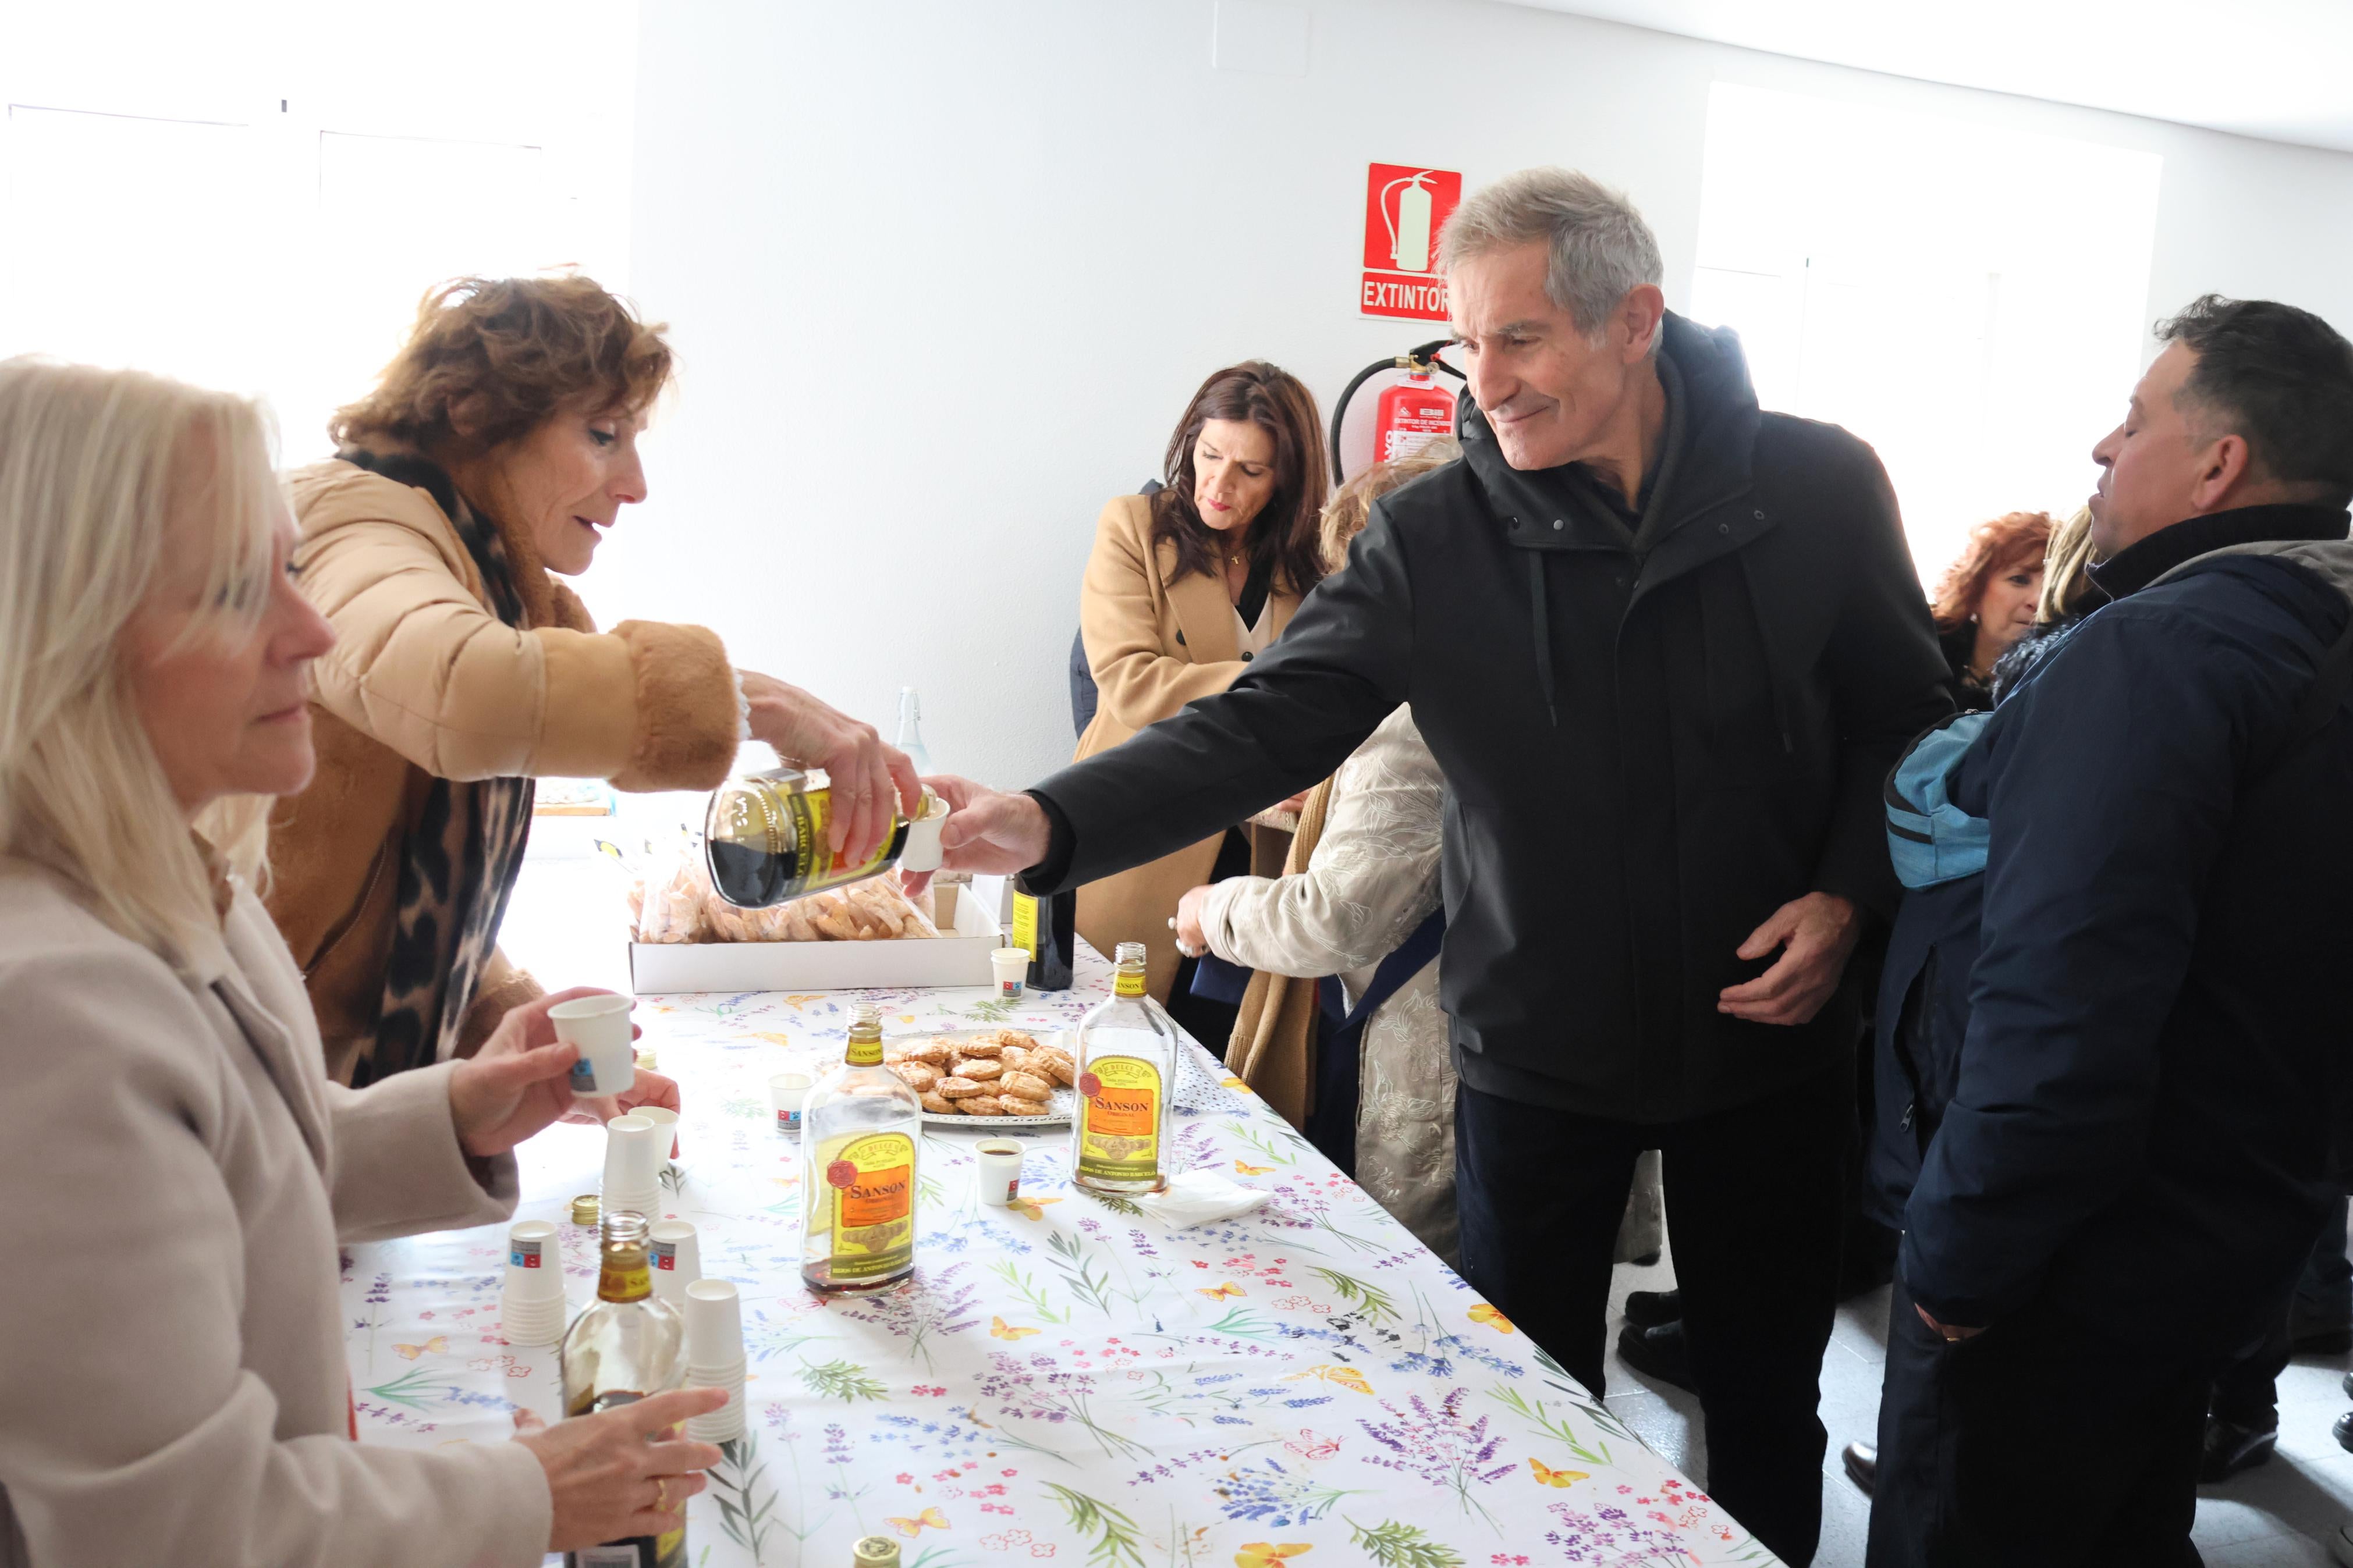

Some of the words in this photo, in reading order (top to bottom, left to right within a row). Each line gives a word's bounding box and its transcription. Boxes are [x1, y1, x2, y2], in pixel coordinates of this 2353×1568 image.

[1364, 280, 1449, 312] EXTINTOR
[1110, 1064, 1134, 1072] DULCE
[1095, 1097, 1149, 1112] SANSON
[850, 1179, 906, 1199] SANSON
